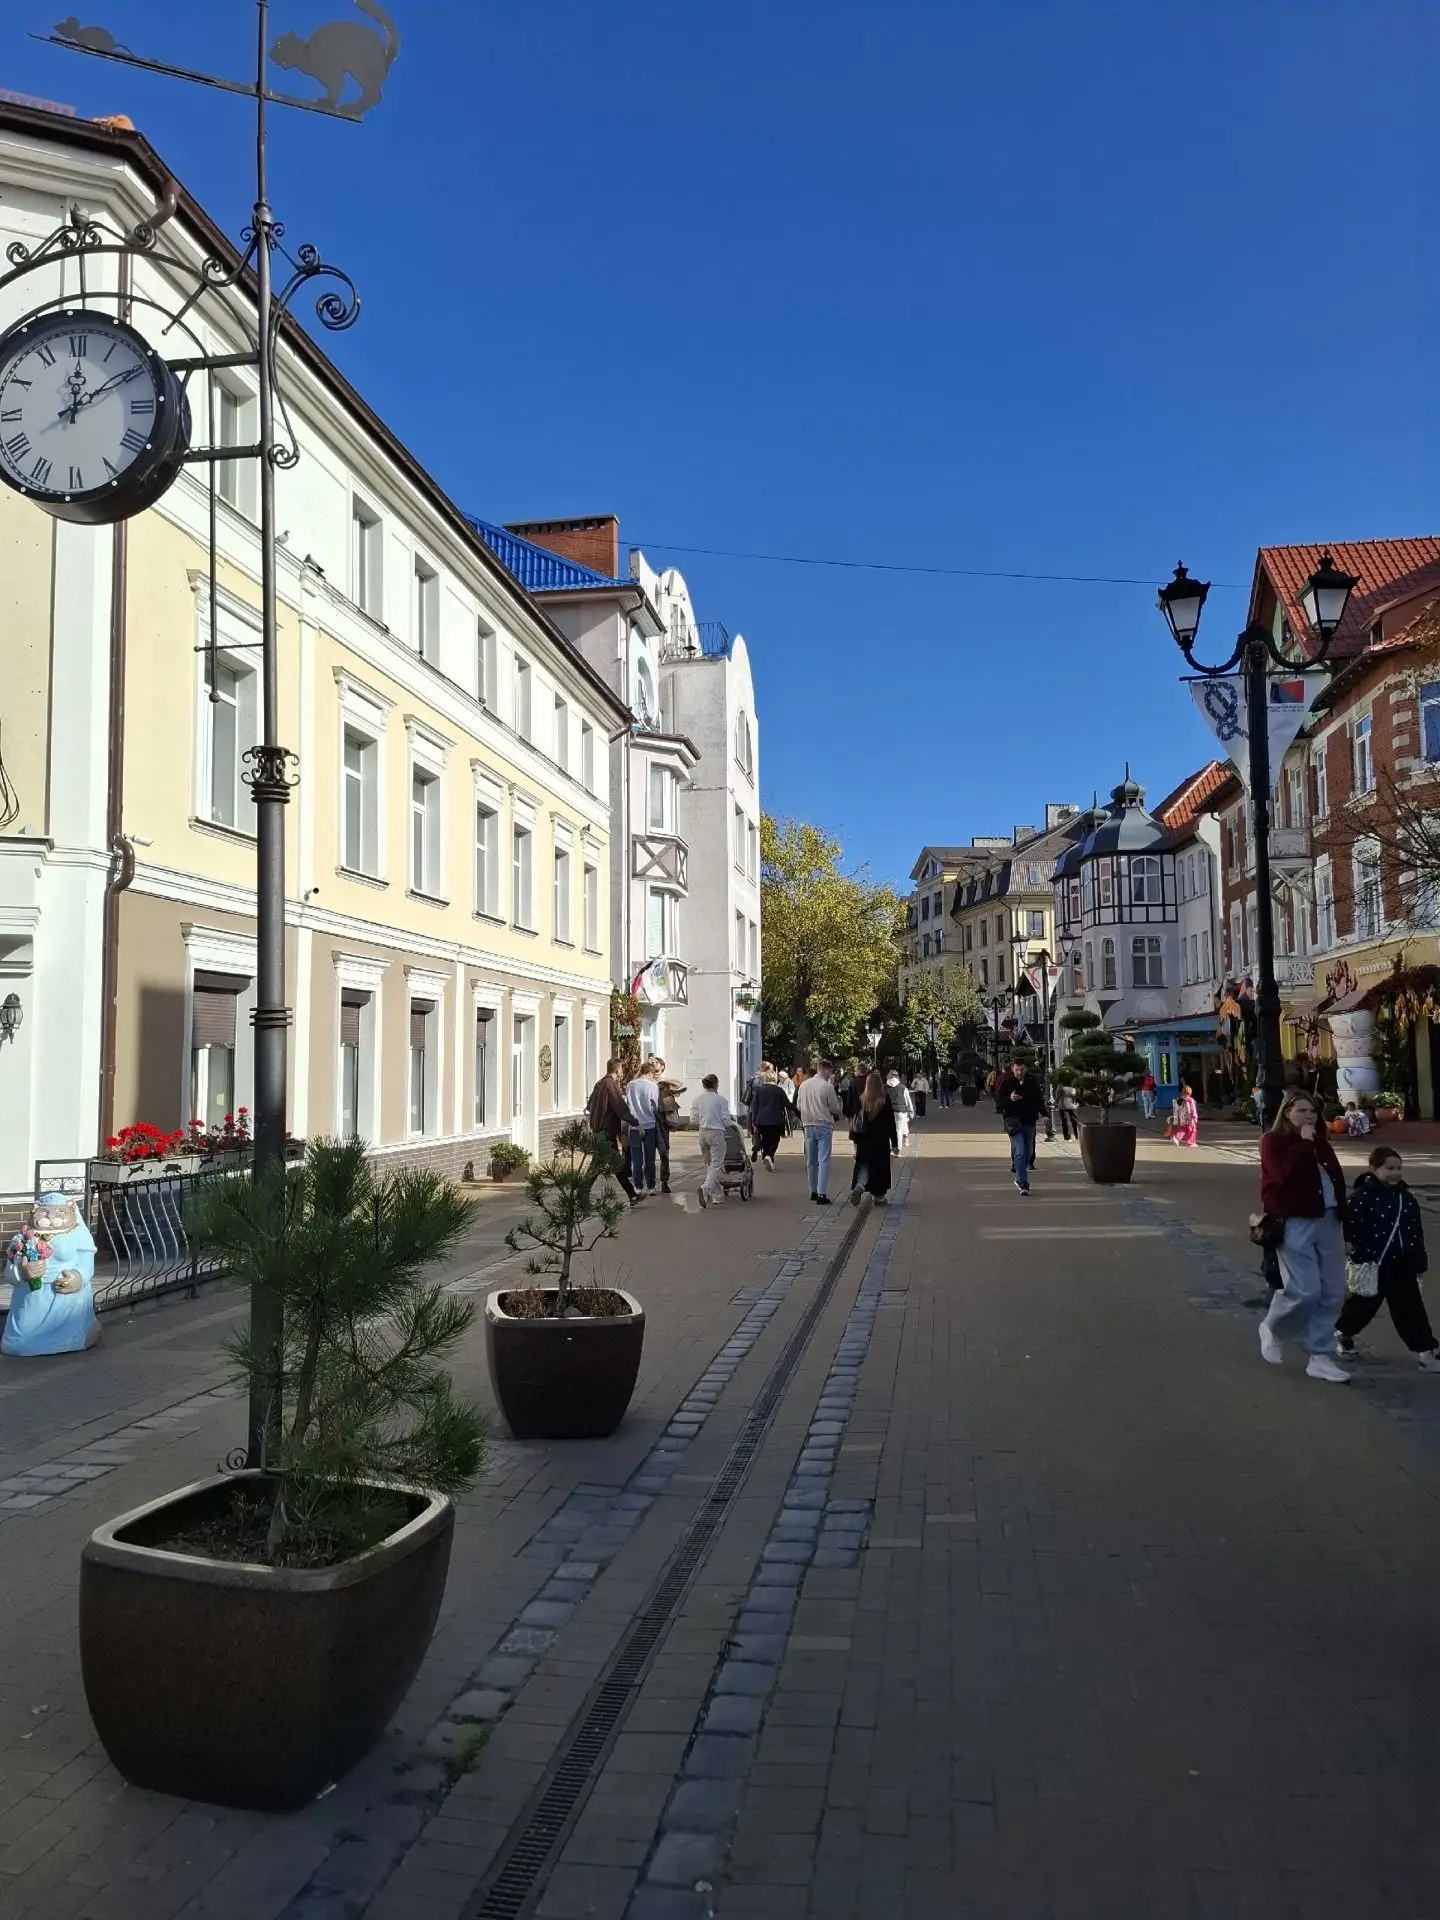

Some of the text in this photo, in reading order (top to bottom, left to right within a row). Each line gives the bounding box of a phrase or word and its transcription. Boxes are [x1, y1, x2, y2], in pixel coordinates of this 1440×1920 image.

[36, 344, 57, 369] XI
[68, 335, 88, 358] XII
[103, 342, 117, 362] I
[10, 374, 33, 392] X
[1, 408, 22, 421] IX
[131, 399, 153, 415] III
[5, 432, 32, 463] VIII
[119, 427, 148, 453] IIII
[30, 456, 53, 485] VII
[69, 466, 84, 489] VI
[102, 456, 119, 478] V
